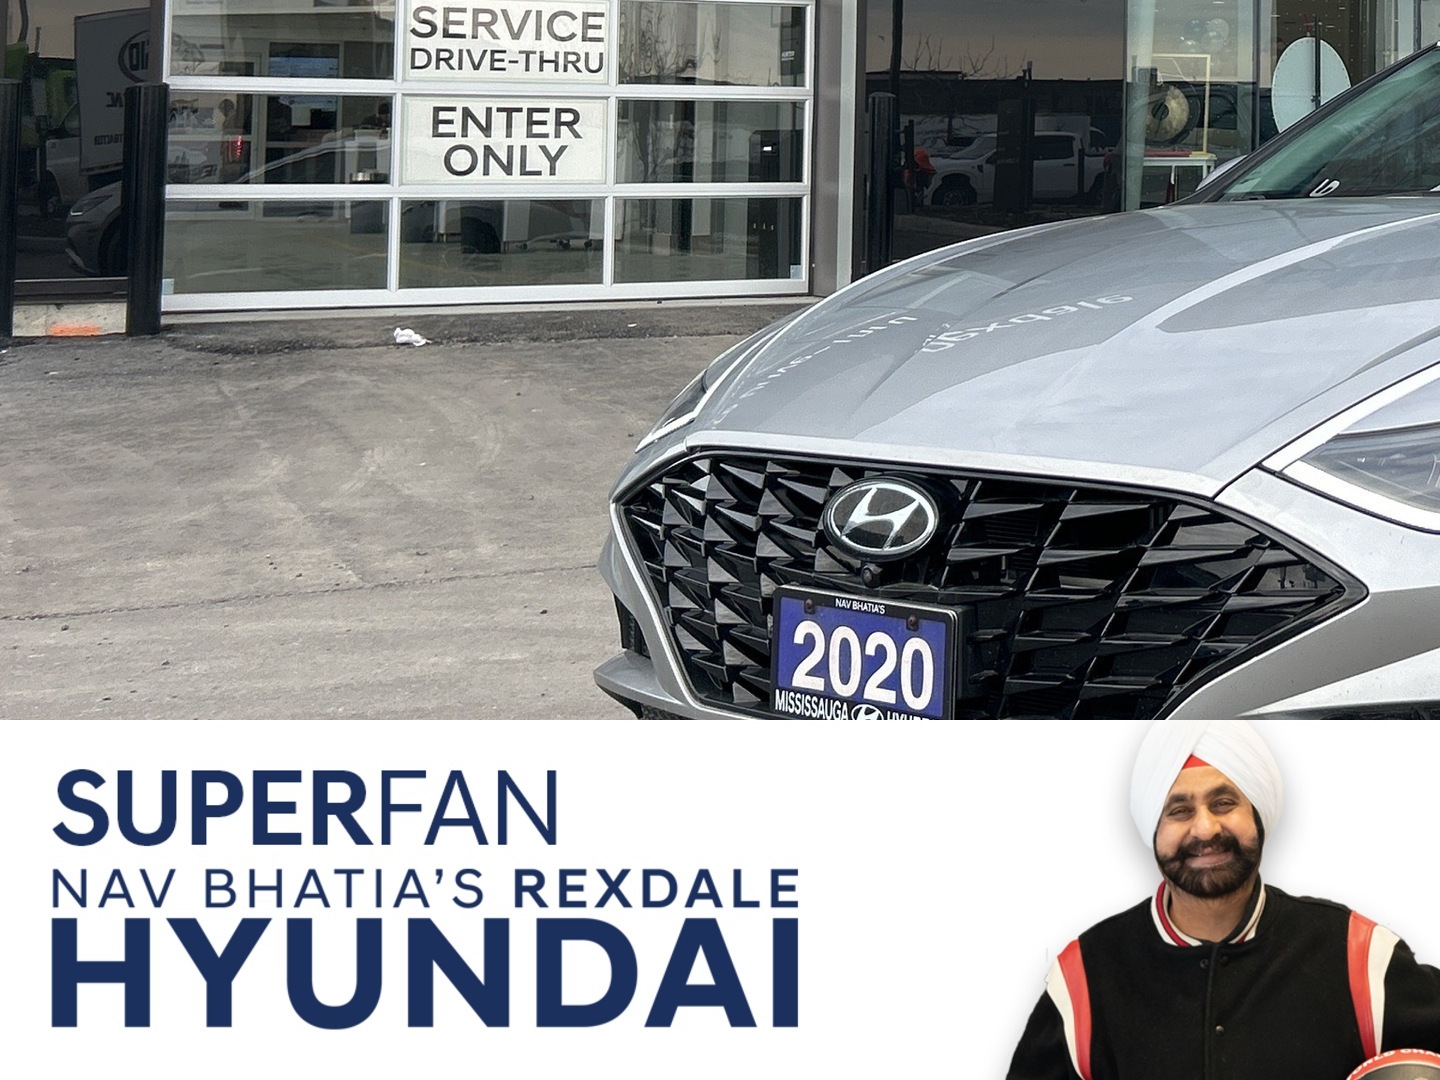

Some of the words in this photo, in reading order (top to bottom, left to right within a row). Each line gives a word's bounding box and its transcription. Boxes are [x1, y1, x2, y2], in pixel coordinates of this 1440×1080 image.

[409, 5, 605, 43] SERVICE
[410, 47, 604, 74] DRIVE-THRU
[431, 106, 582, 139] ENTER
[443, 143, 568, 177] ONLY
[835, 597, 851, 609] NAV
[852, 599, 886, 614] BHATIA'S
[791, 620, 934, 711] 2020
[775, 689, 849, 720] MISSISSAUGA
